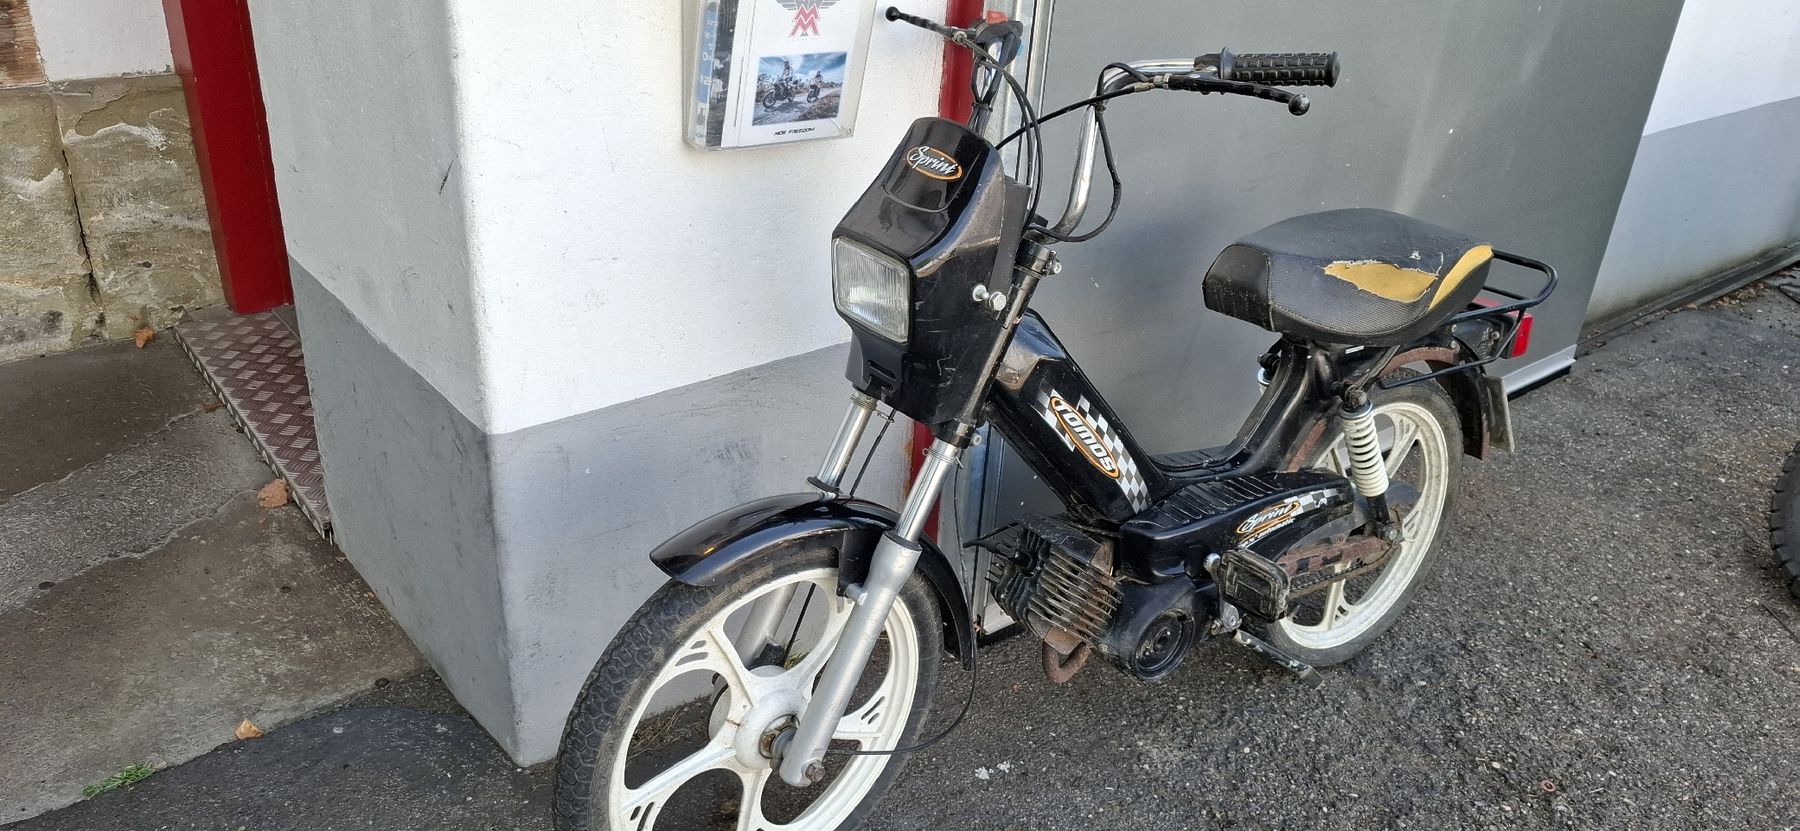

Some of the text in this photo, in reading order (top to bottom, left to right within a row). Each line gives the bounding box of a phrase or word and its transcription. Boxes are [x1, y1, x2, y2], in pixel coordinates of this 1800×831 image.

[909, 145, 959, 175] Sprint
[1055, 400, 1115, 471] TOMOS
[1241, 502, 1293, 533] Sprint
